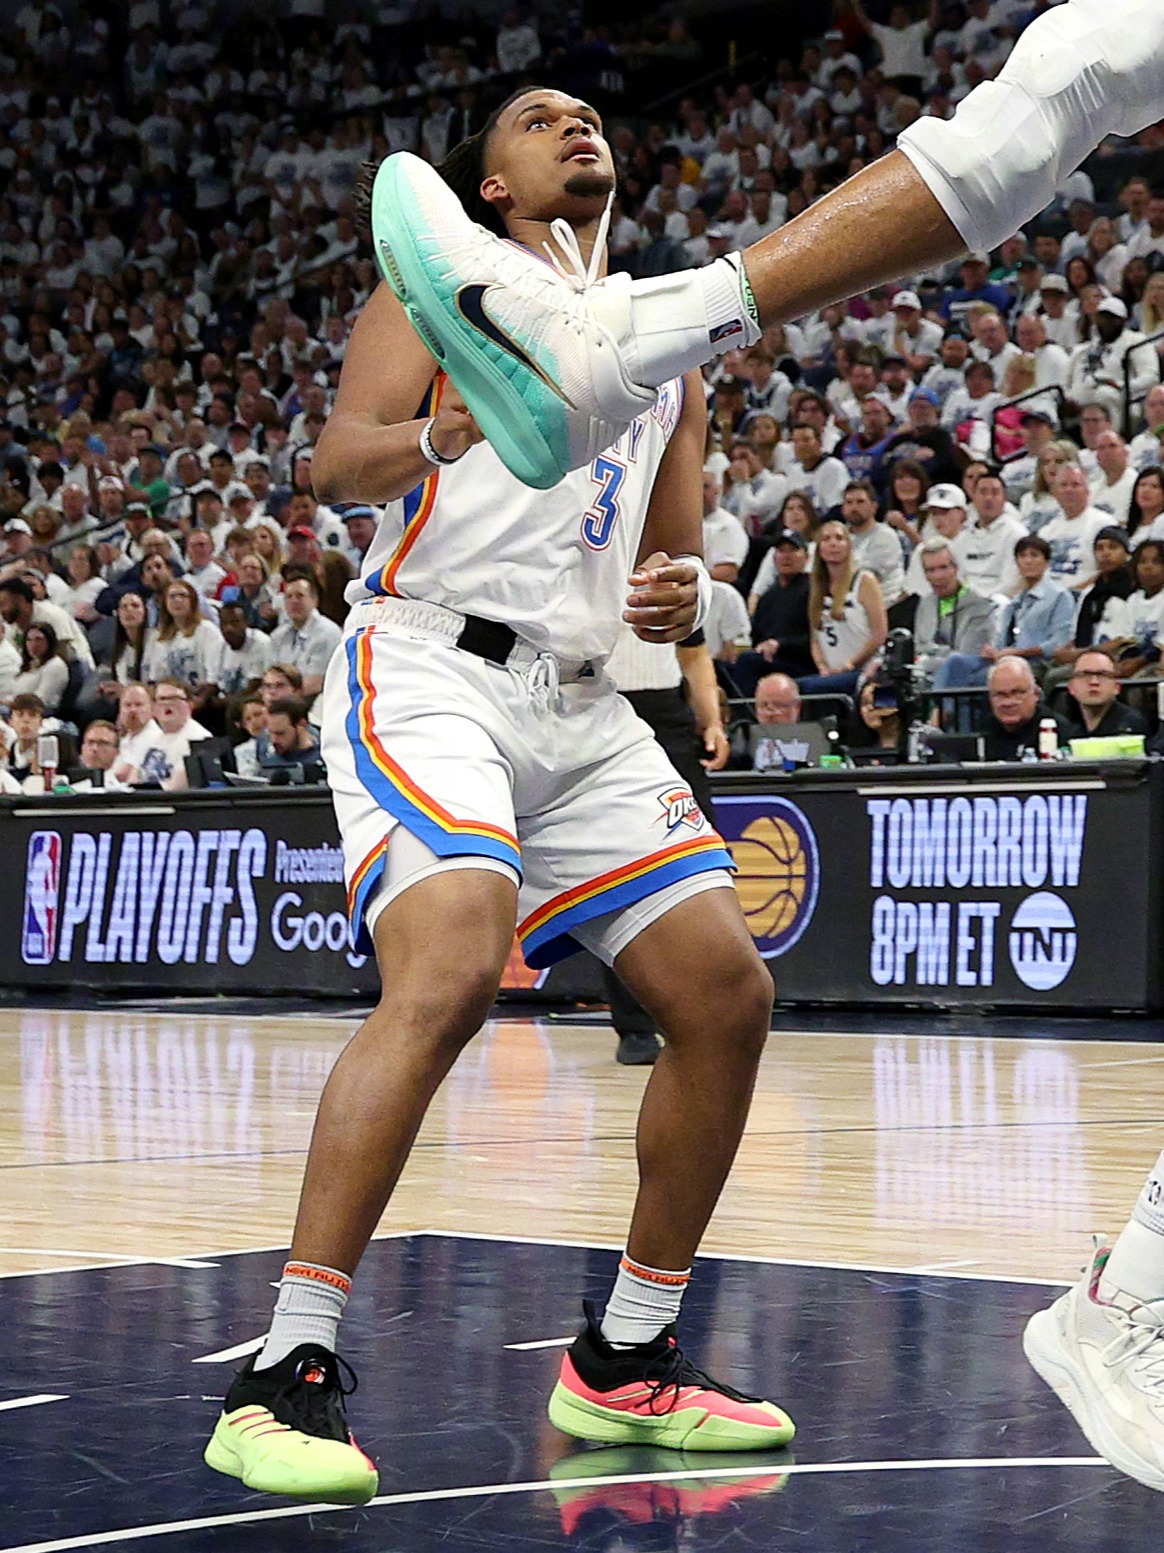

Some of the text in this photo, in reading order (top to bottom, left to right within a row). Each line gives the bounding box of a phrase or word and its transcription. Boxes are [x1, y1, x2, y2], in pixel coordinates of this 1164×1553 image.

[581, 453, 627, 552] 3
[867, 794, 1088, 889] TOMORROW
[58, 827, 267, 966] PLAYOFFS
[870, 894, 1001, 986] 8PM ET
